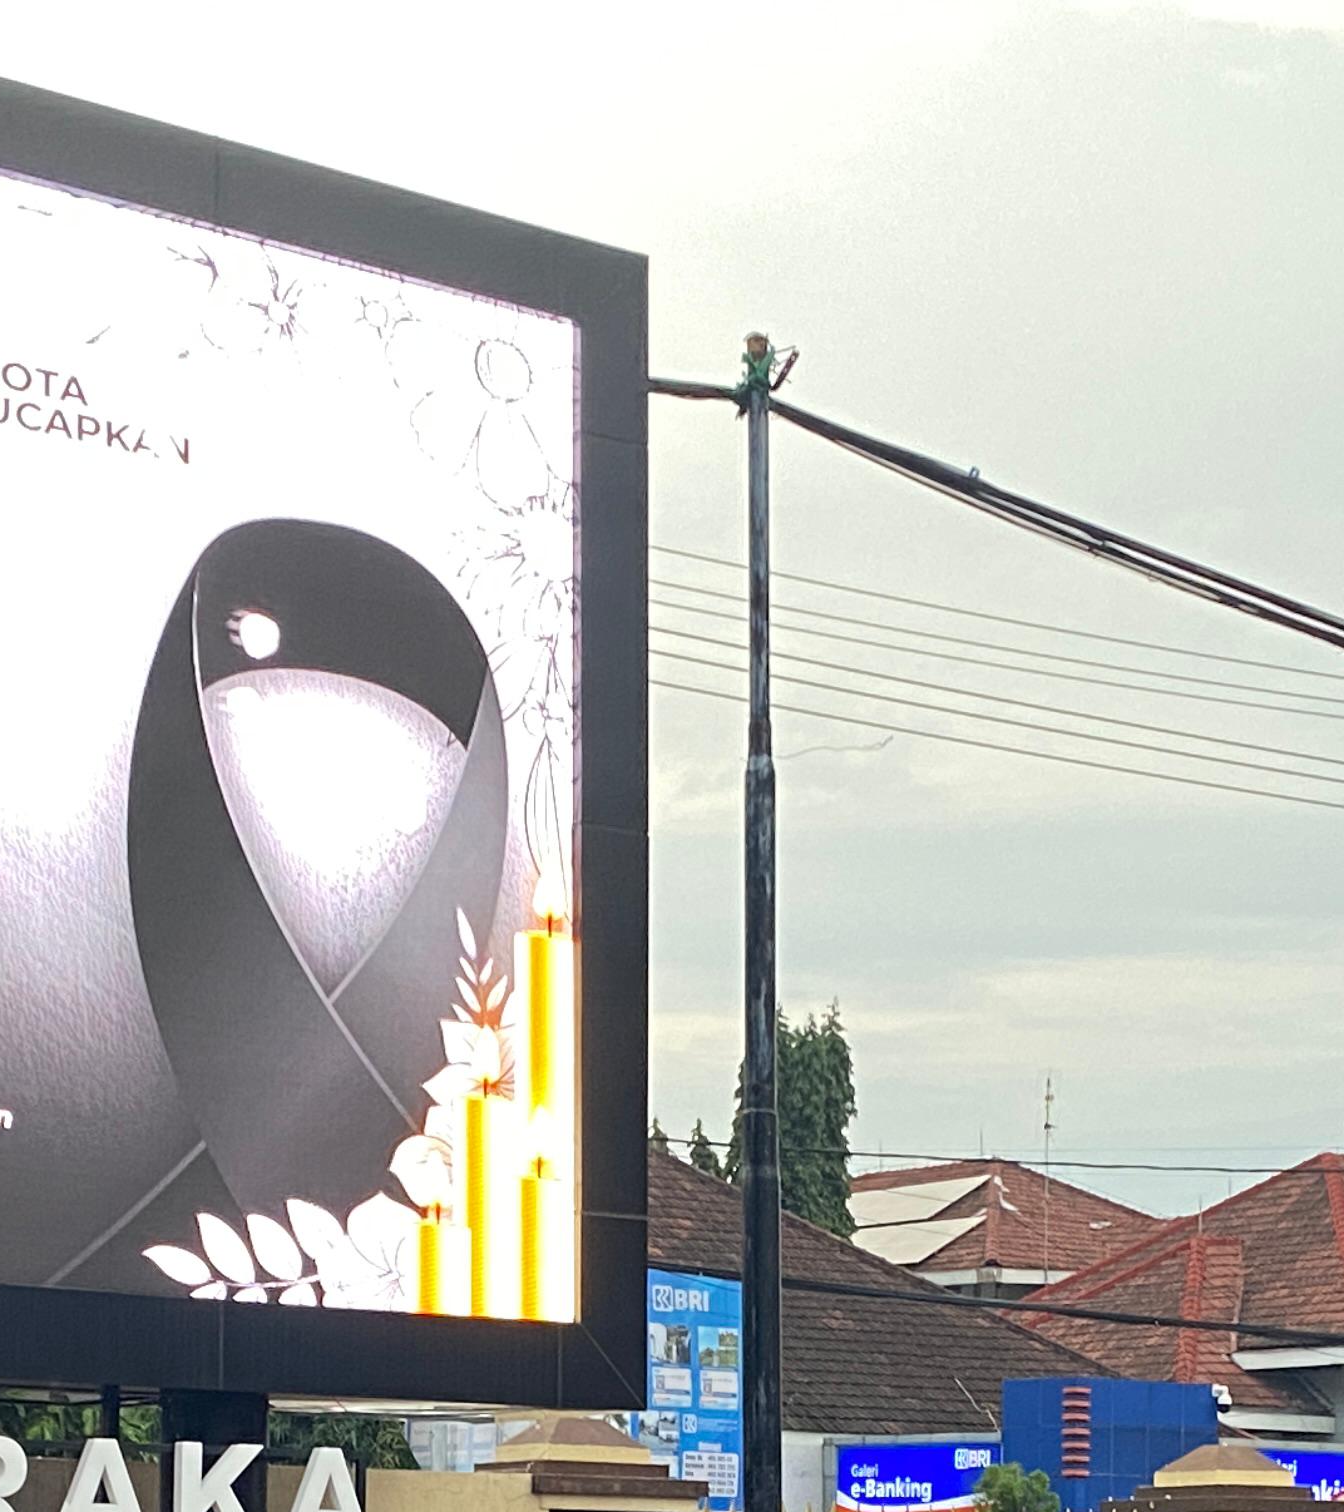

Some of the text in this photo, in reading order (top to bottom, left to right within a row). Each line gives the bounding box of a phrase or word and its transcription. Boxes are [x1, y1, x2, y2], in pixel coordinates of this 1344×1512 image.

[675, 1289, 709, 1312] BRI
[968, 1449, 991, 1468] BRI
[851, 1464, 878, 1478] Galeri
[850, 1477, 932, 1502] e-Banking
